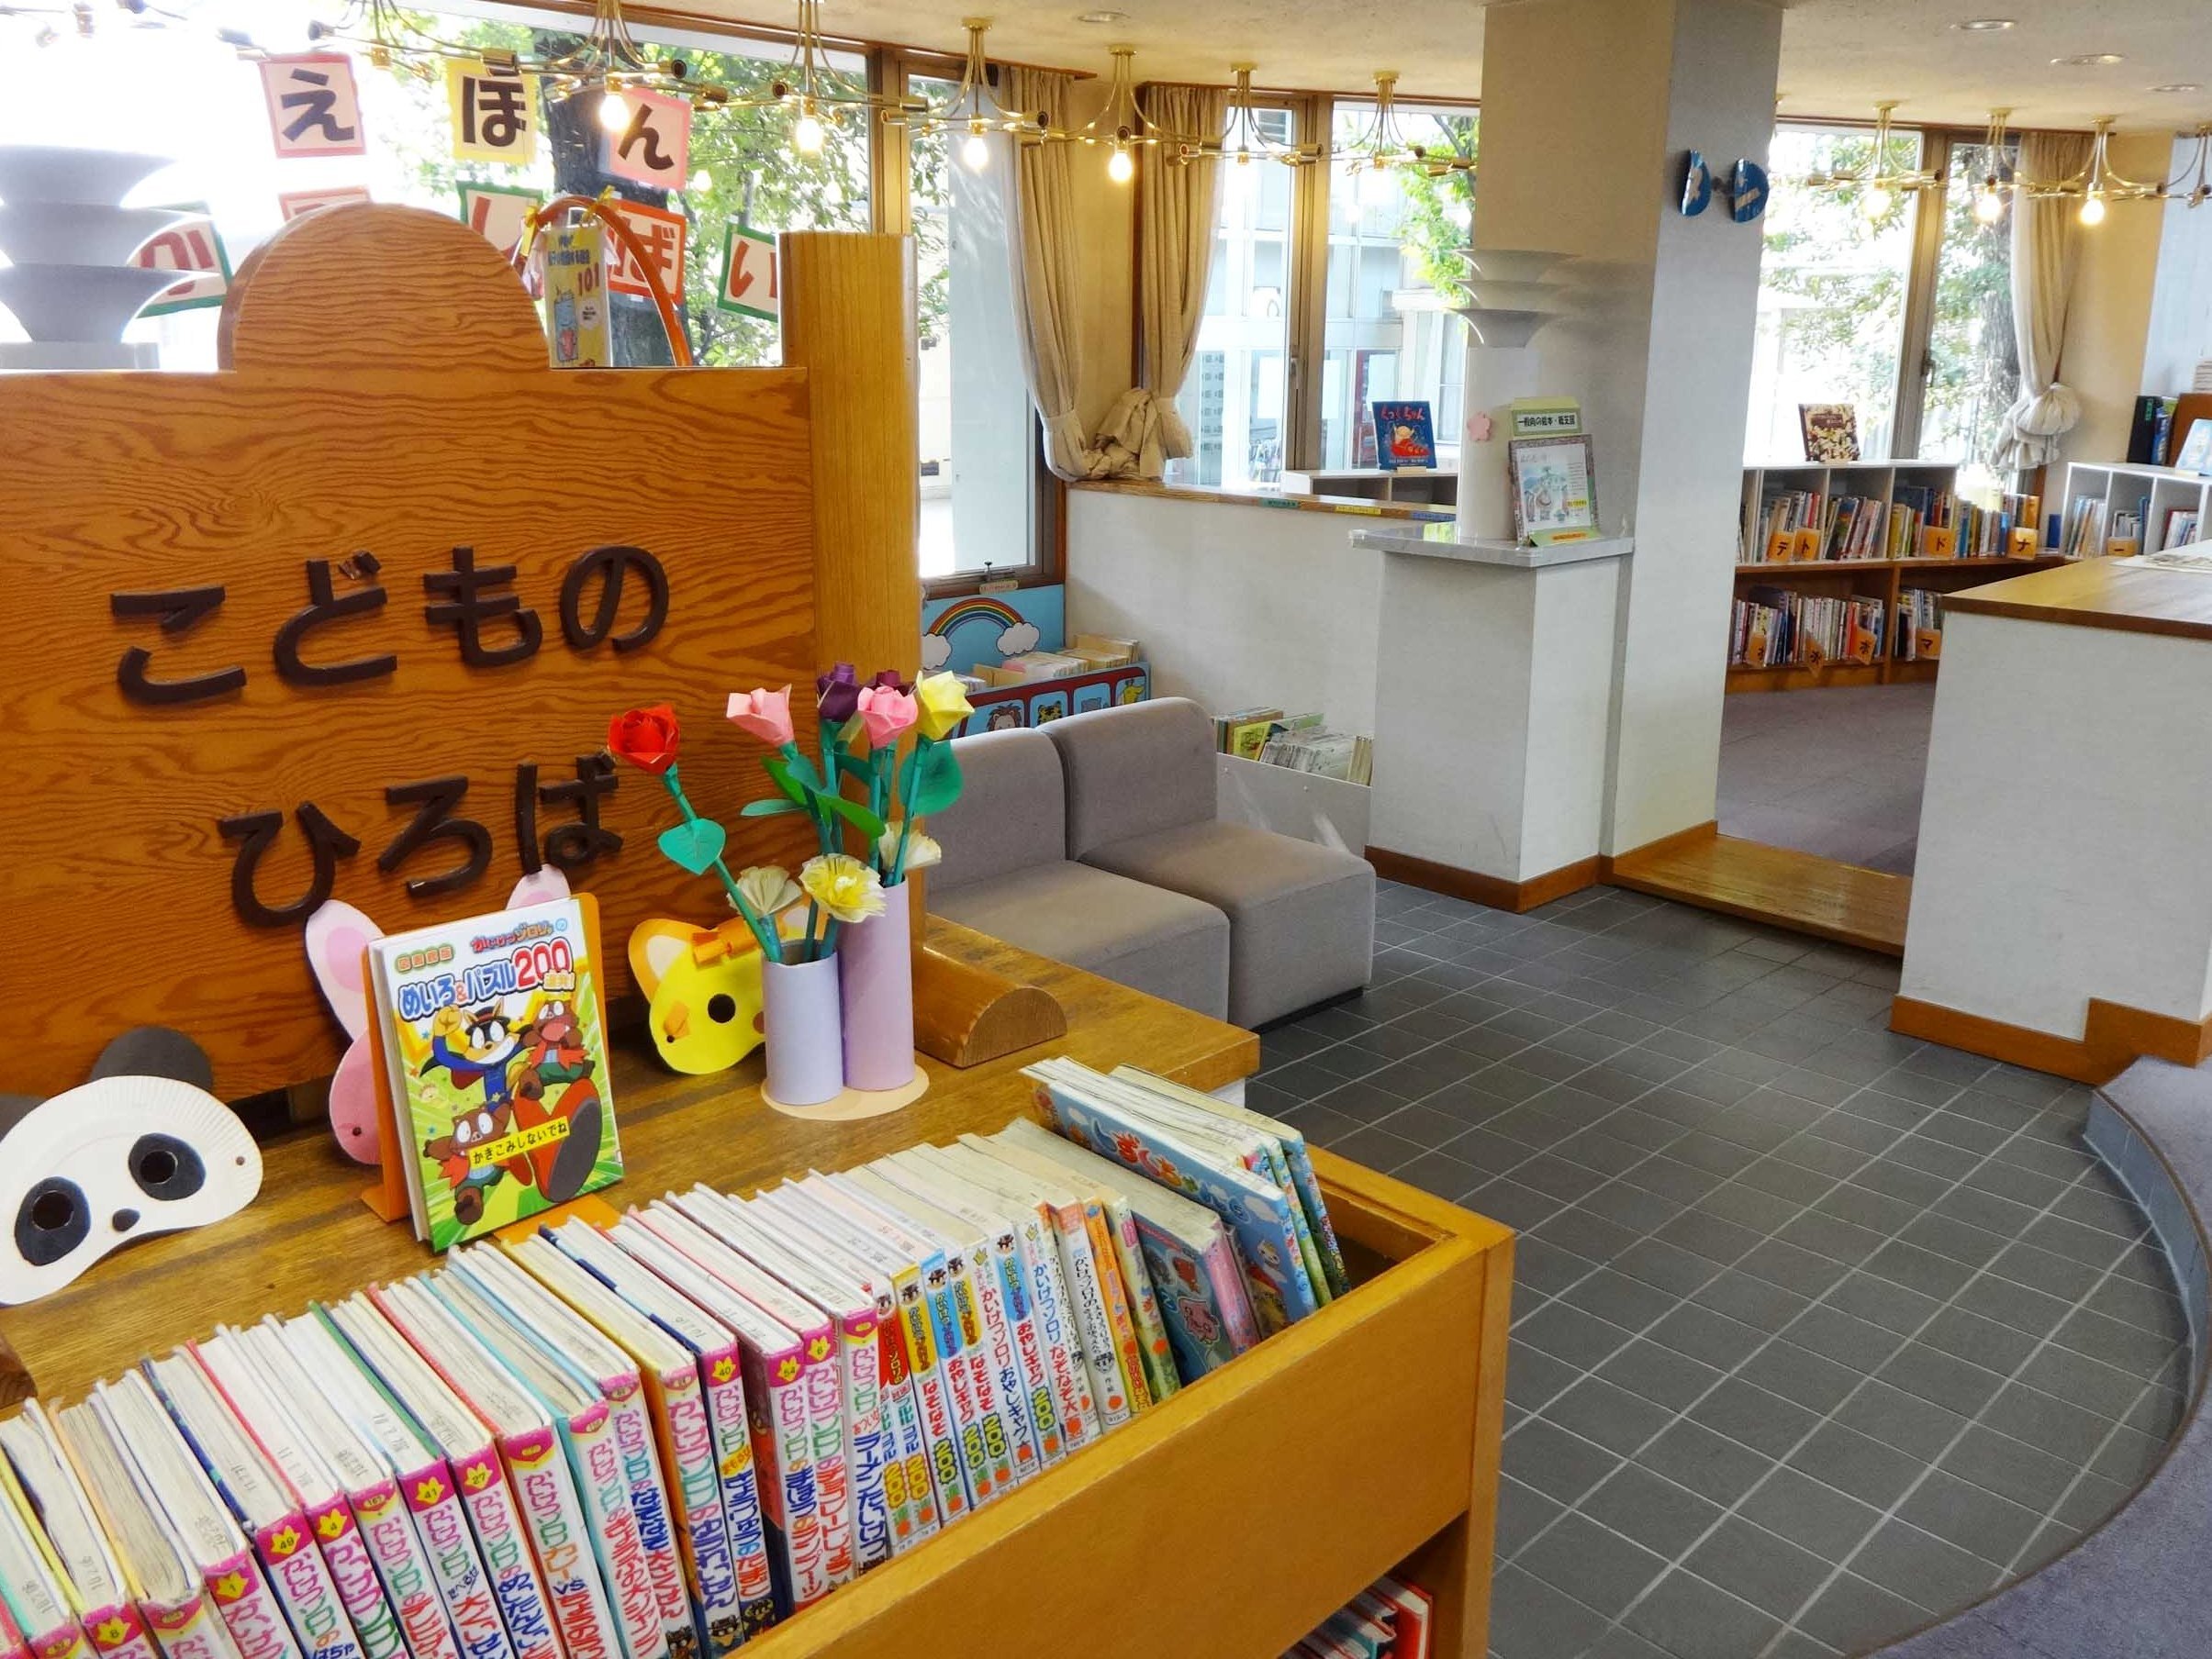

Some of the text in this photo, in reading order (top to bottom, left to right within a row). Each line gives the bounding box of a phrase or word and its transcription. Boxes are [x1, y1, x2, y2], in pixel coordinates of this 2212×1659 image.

[577, 262, 600, 297] 101
[109, 544, 671, 706] こどもの
[217, 751, 624, 928] ひろば
[472, 1121, 569, 1164] かきこみしないでね
[980, 1287, 1011, 1369] かいけつゾロリ
[1033, 1263, 1062, 1344] かいけつゾロリ
[719, 1366, 732, 1376] 40
[1017, 1320, 1045, 1388] おやじギャグ
[1033, 1388, 1056, 1431] 200
[922, 1377, 946, 1438] なぞなぞ
[948, 1355, 976, 1424] おやじギャグ
[963, 1423, 986, 1470] 200
[969, 1353, 995, 1411] なぞなぞ
[983, 1413, 1007, 1458] 200
[472, 1472, 486, 1485] 27
[884, 1461, 906, 1508] 200
[906, 1453, 930, 1500] 200
[933, 1439, 957, 1484] 200
[424, 1487, 438, 1500] 41
[853, 1431, 886, 1558] ラーメンたいけつ
[279, 1537, 296, 1551] 49
